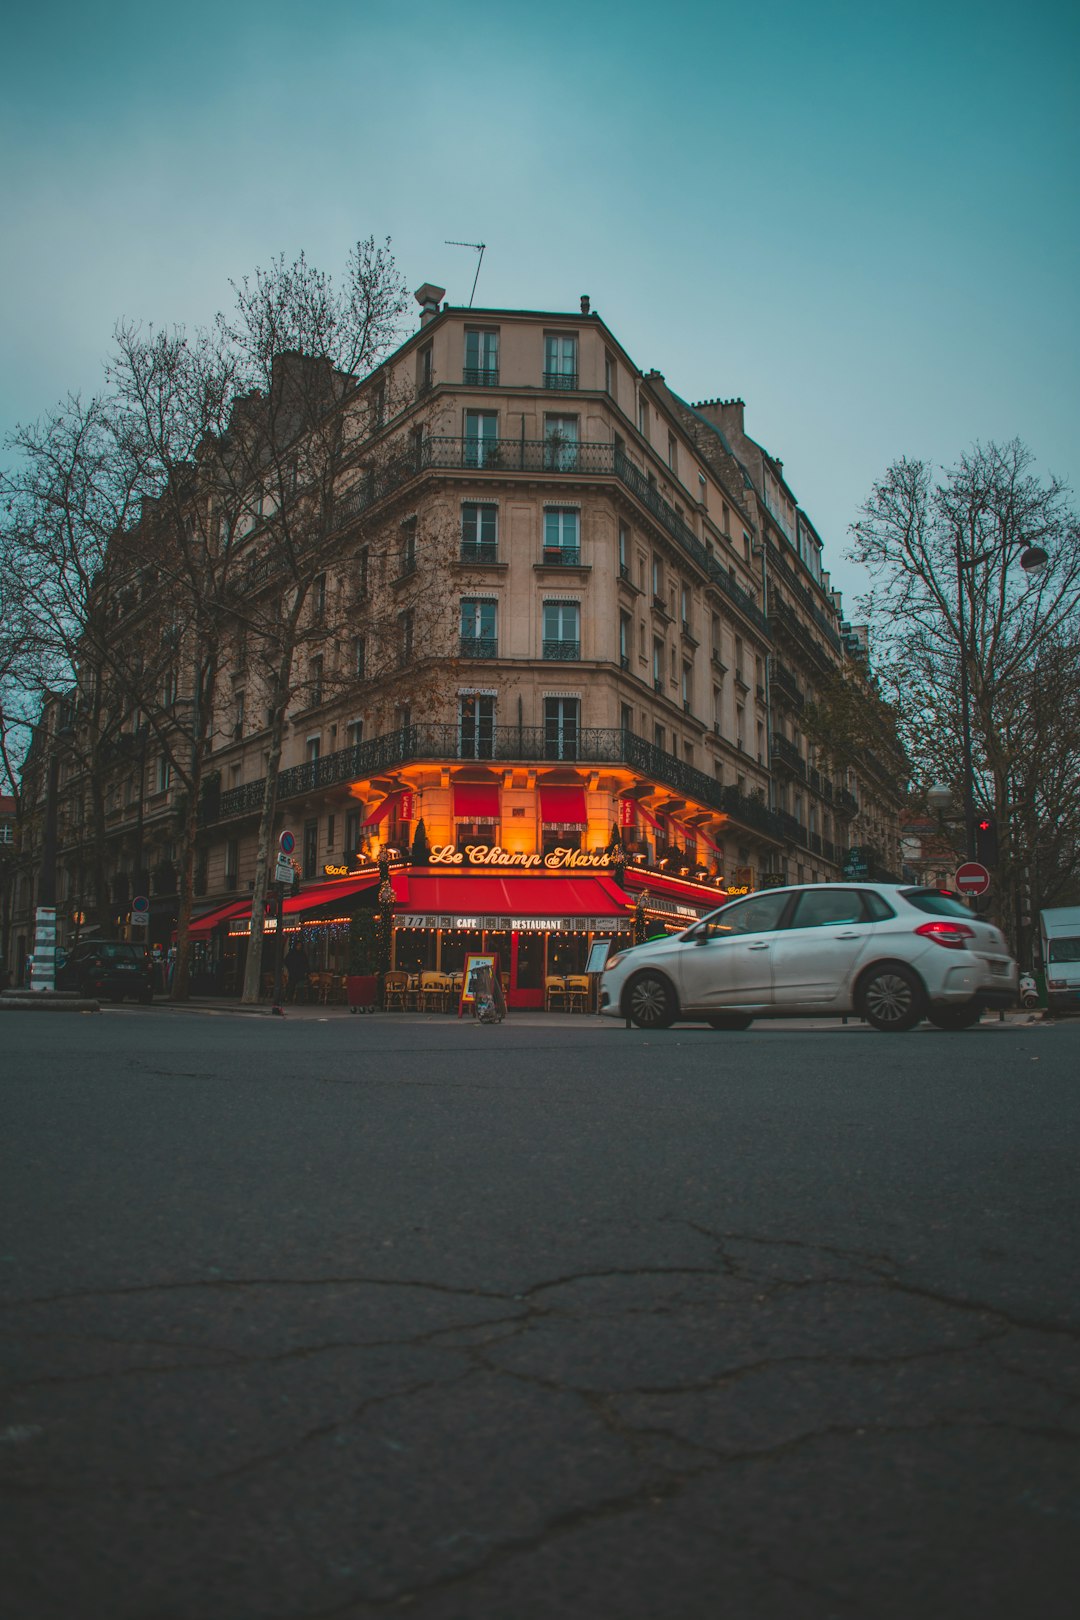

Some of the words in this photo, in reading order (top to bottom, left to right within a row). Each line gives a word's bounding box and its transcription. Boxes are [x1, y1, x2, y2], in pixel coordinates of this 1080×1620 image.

[429, 844, 464, 864] Le
[465, 845, 542, 868] Champ
[546, 847, 612, 869] Mars
[547, 856, 560, 866] de
[408, 917, 424, 926] 7/7
[456, 918, 477, 928] CAFE
[511, 919, 562, 930] RESTAURANT
